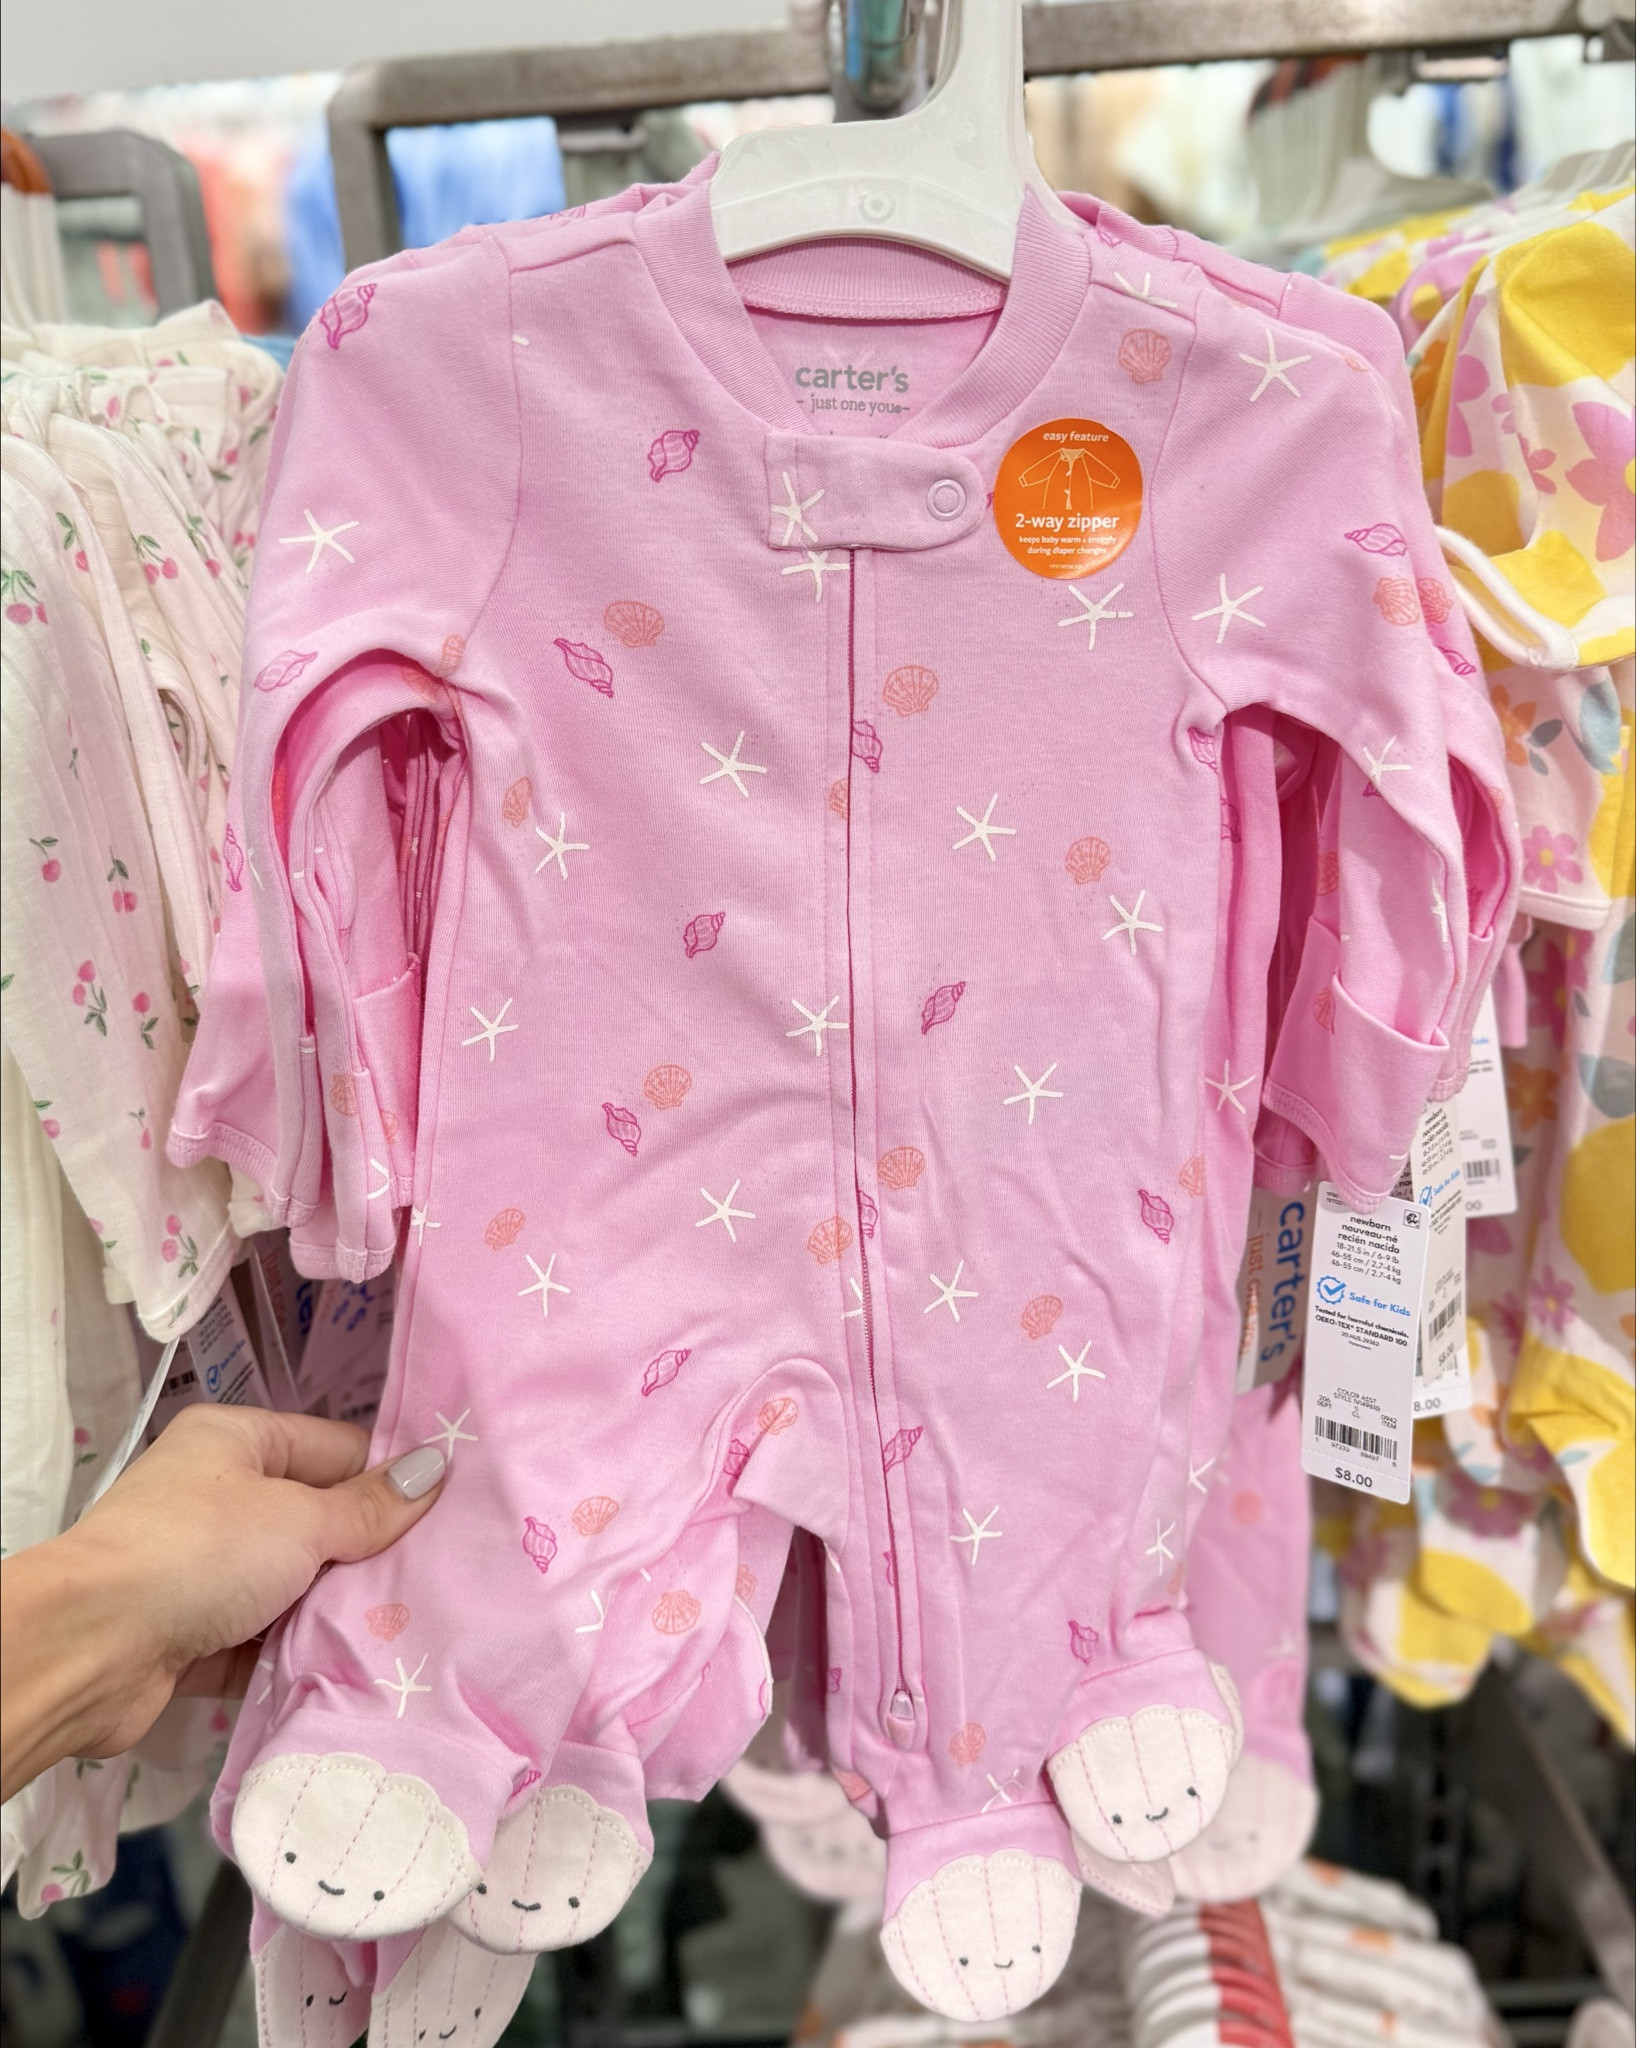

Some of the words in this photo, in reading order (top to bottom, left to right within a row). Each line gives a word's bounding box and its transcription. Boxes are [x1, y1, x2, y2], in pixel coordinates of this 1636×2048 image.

[795, 365, 909, 393] carter's
[810, 393, 838, 414] just
[841, 399, 866, 412] one
[1043, 433, 1068, 443] easy
[1070, 431, 1109, 442] feature
[1015, 513, 1064, 532] 2-way
[1067, 513, 1120, 532] zipper
[1019, 536, 1040, 545] keeps
[1042, 535, 1059, 545] baby
[1027, 547, 1051, 555] during
[1052, 547, 1075, 555] diaper
[1077, 547, 1107, 555] changes
[1341, 1224, 1398, 1243] nouveau-né
[1350, 1216, 1391, 1231] newborn
[1247, 1232, 1269, 1275] just
[1336, 1242, 1361, 1254] 18-21.5
[1377, 1253, 1390, 1261] 6-9
[1392, 1256, 1399, 1264] lb
[1338, 1233, 1366, 1245] recién
[1368, 1240, 1400, 1254] nacido
[1331, 1250, 1352, 1260] 46-55
[1371, 1261, 1391, 1271] 2.7-4
[1392, 1265, 1401, 1275] kg
[1331, 1260, 1352, 1270] 46-55
[1371, 1270, 1391, 1280] 2.7-4
[1392, 1275, 1402, 1285] kg
[1260, 1201, 1305, 1362] carter's
[1349, 1292, 1371, 1305] Safe
[1373, 1299, 1388, 1310] for
[1390, 1303, 1411, 1316] Kids
[1315, 1305, 1336, 1317] Tested
[1348, 1314, 1374, 1327] harmful
[1356, 1326, 1394, 1342] STANDARD
[1395, 1338, 1408, 1347] 100
[1335, 1466, 1373, 1488] $8.00
